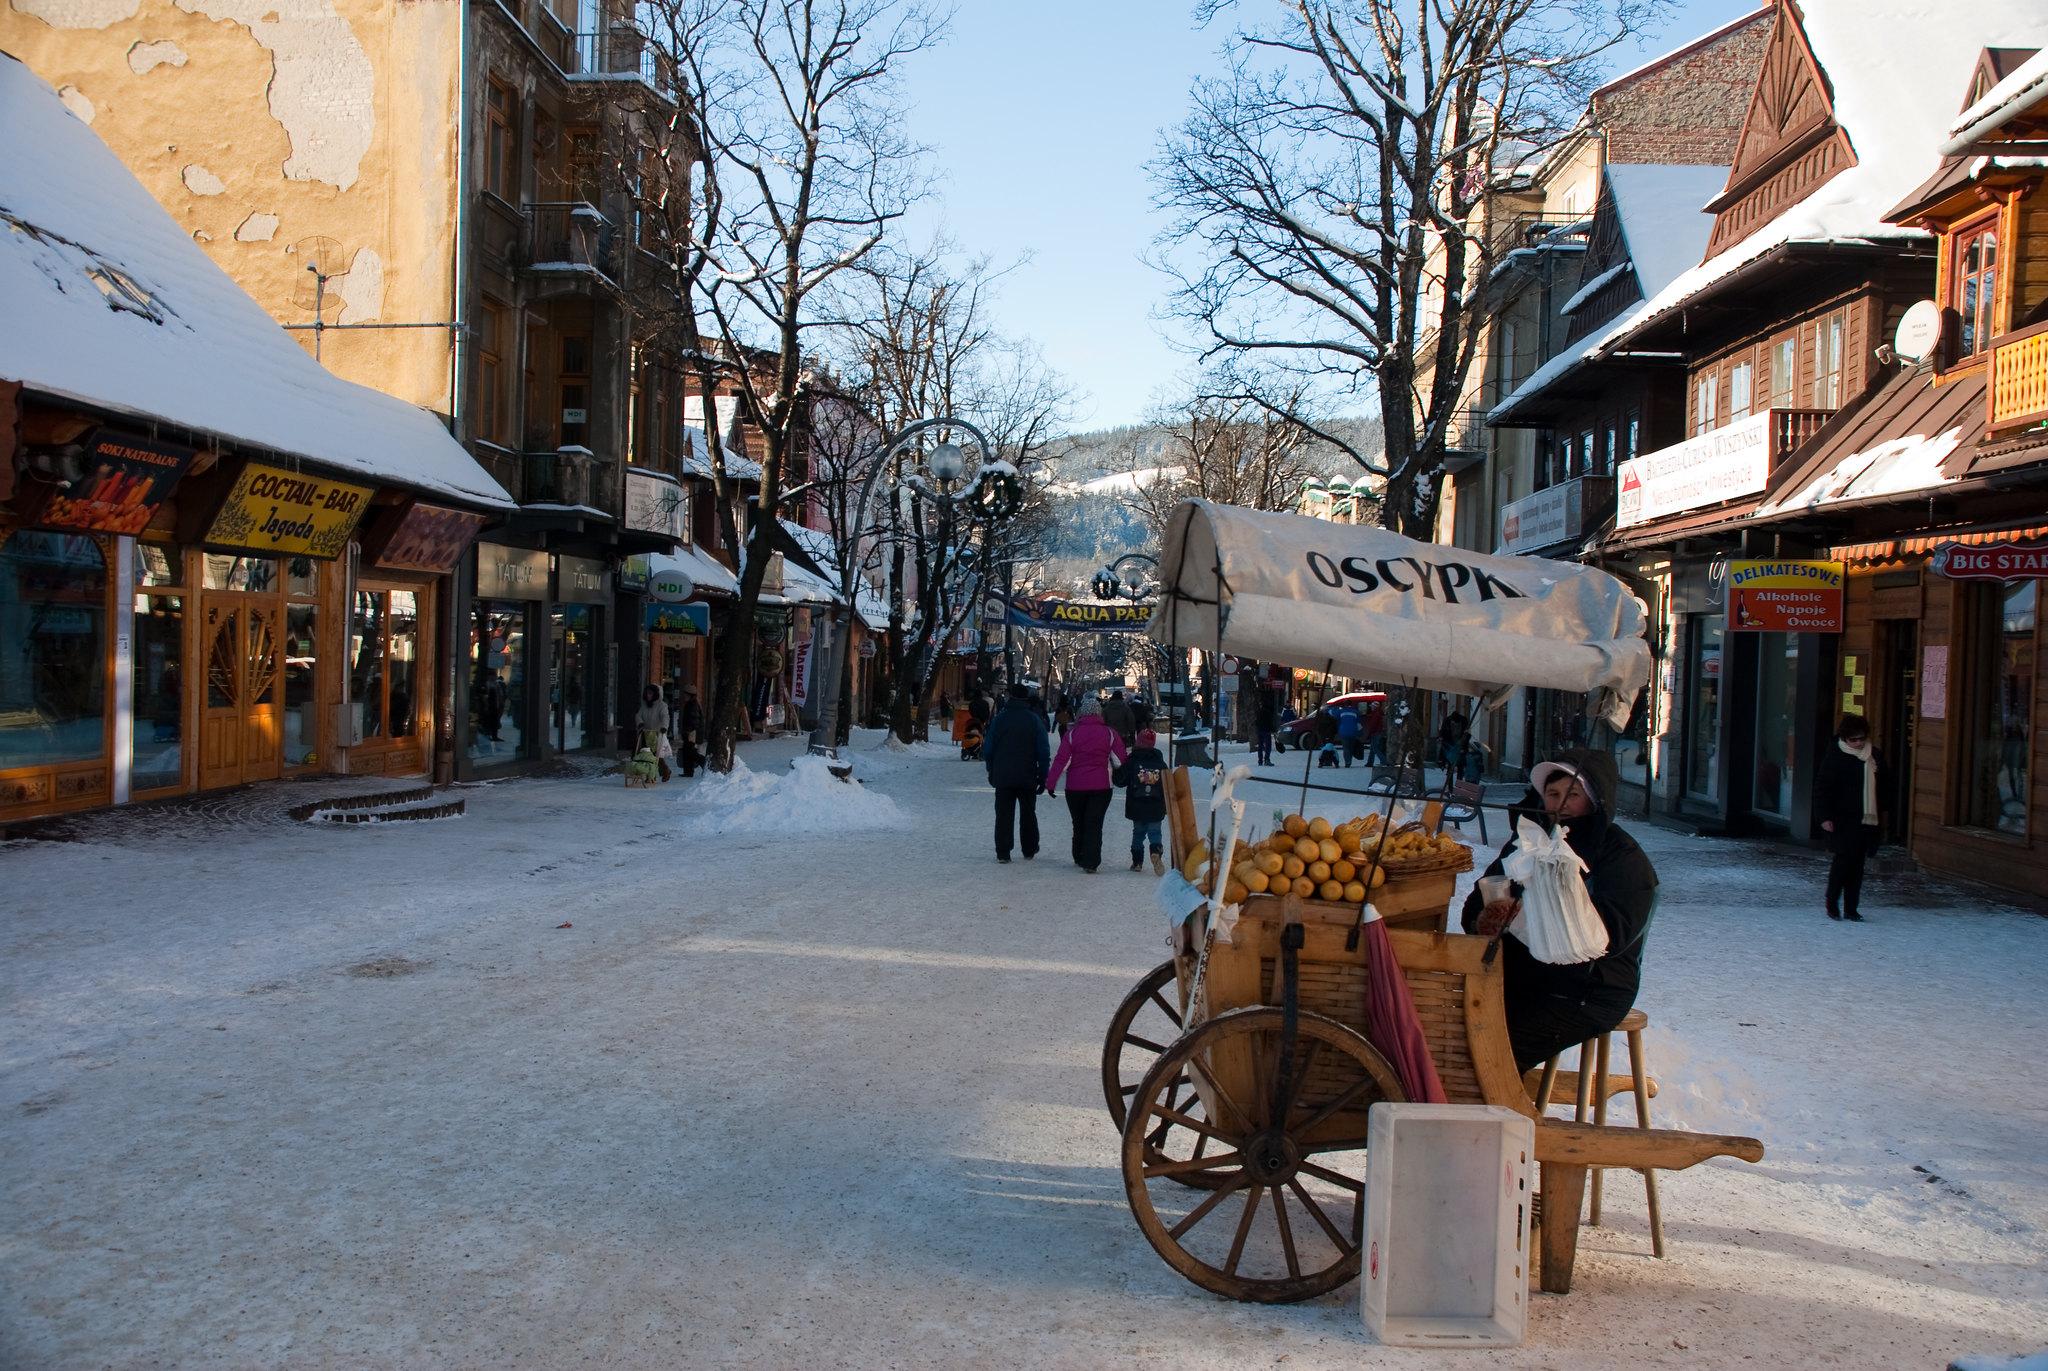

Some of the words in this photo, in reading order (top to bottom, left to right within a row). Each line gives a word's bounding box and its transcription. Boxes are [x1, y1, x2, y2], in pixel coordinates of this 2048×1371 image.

[97, 443, 124, 457] SOKI
[123, 447, 180, 467] NATURALNE
[259, 505, 315, 542] Jagoda
[1953, 554, 1991, 569] BIG
[1732, 563, 1841, 586] DELIKATESOWE
[657, 582, 683, 594] HDI
[1756, 592, 1822, 602] Alkohole
[1052, 604, 1110, 622] AQUA
[1776, 604, 1827, 616] Napoje
[1787, 617, 1836, 627] Owoce
[795, 643, 811, 699] MARKER
